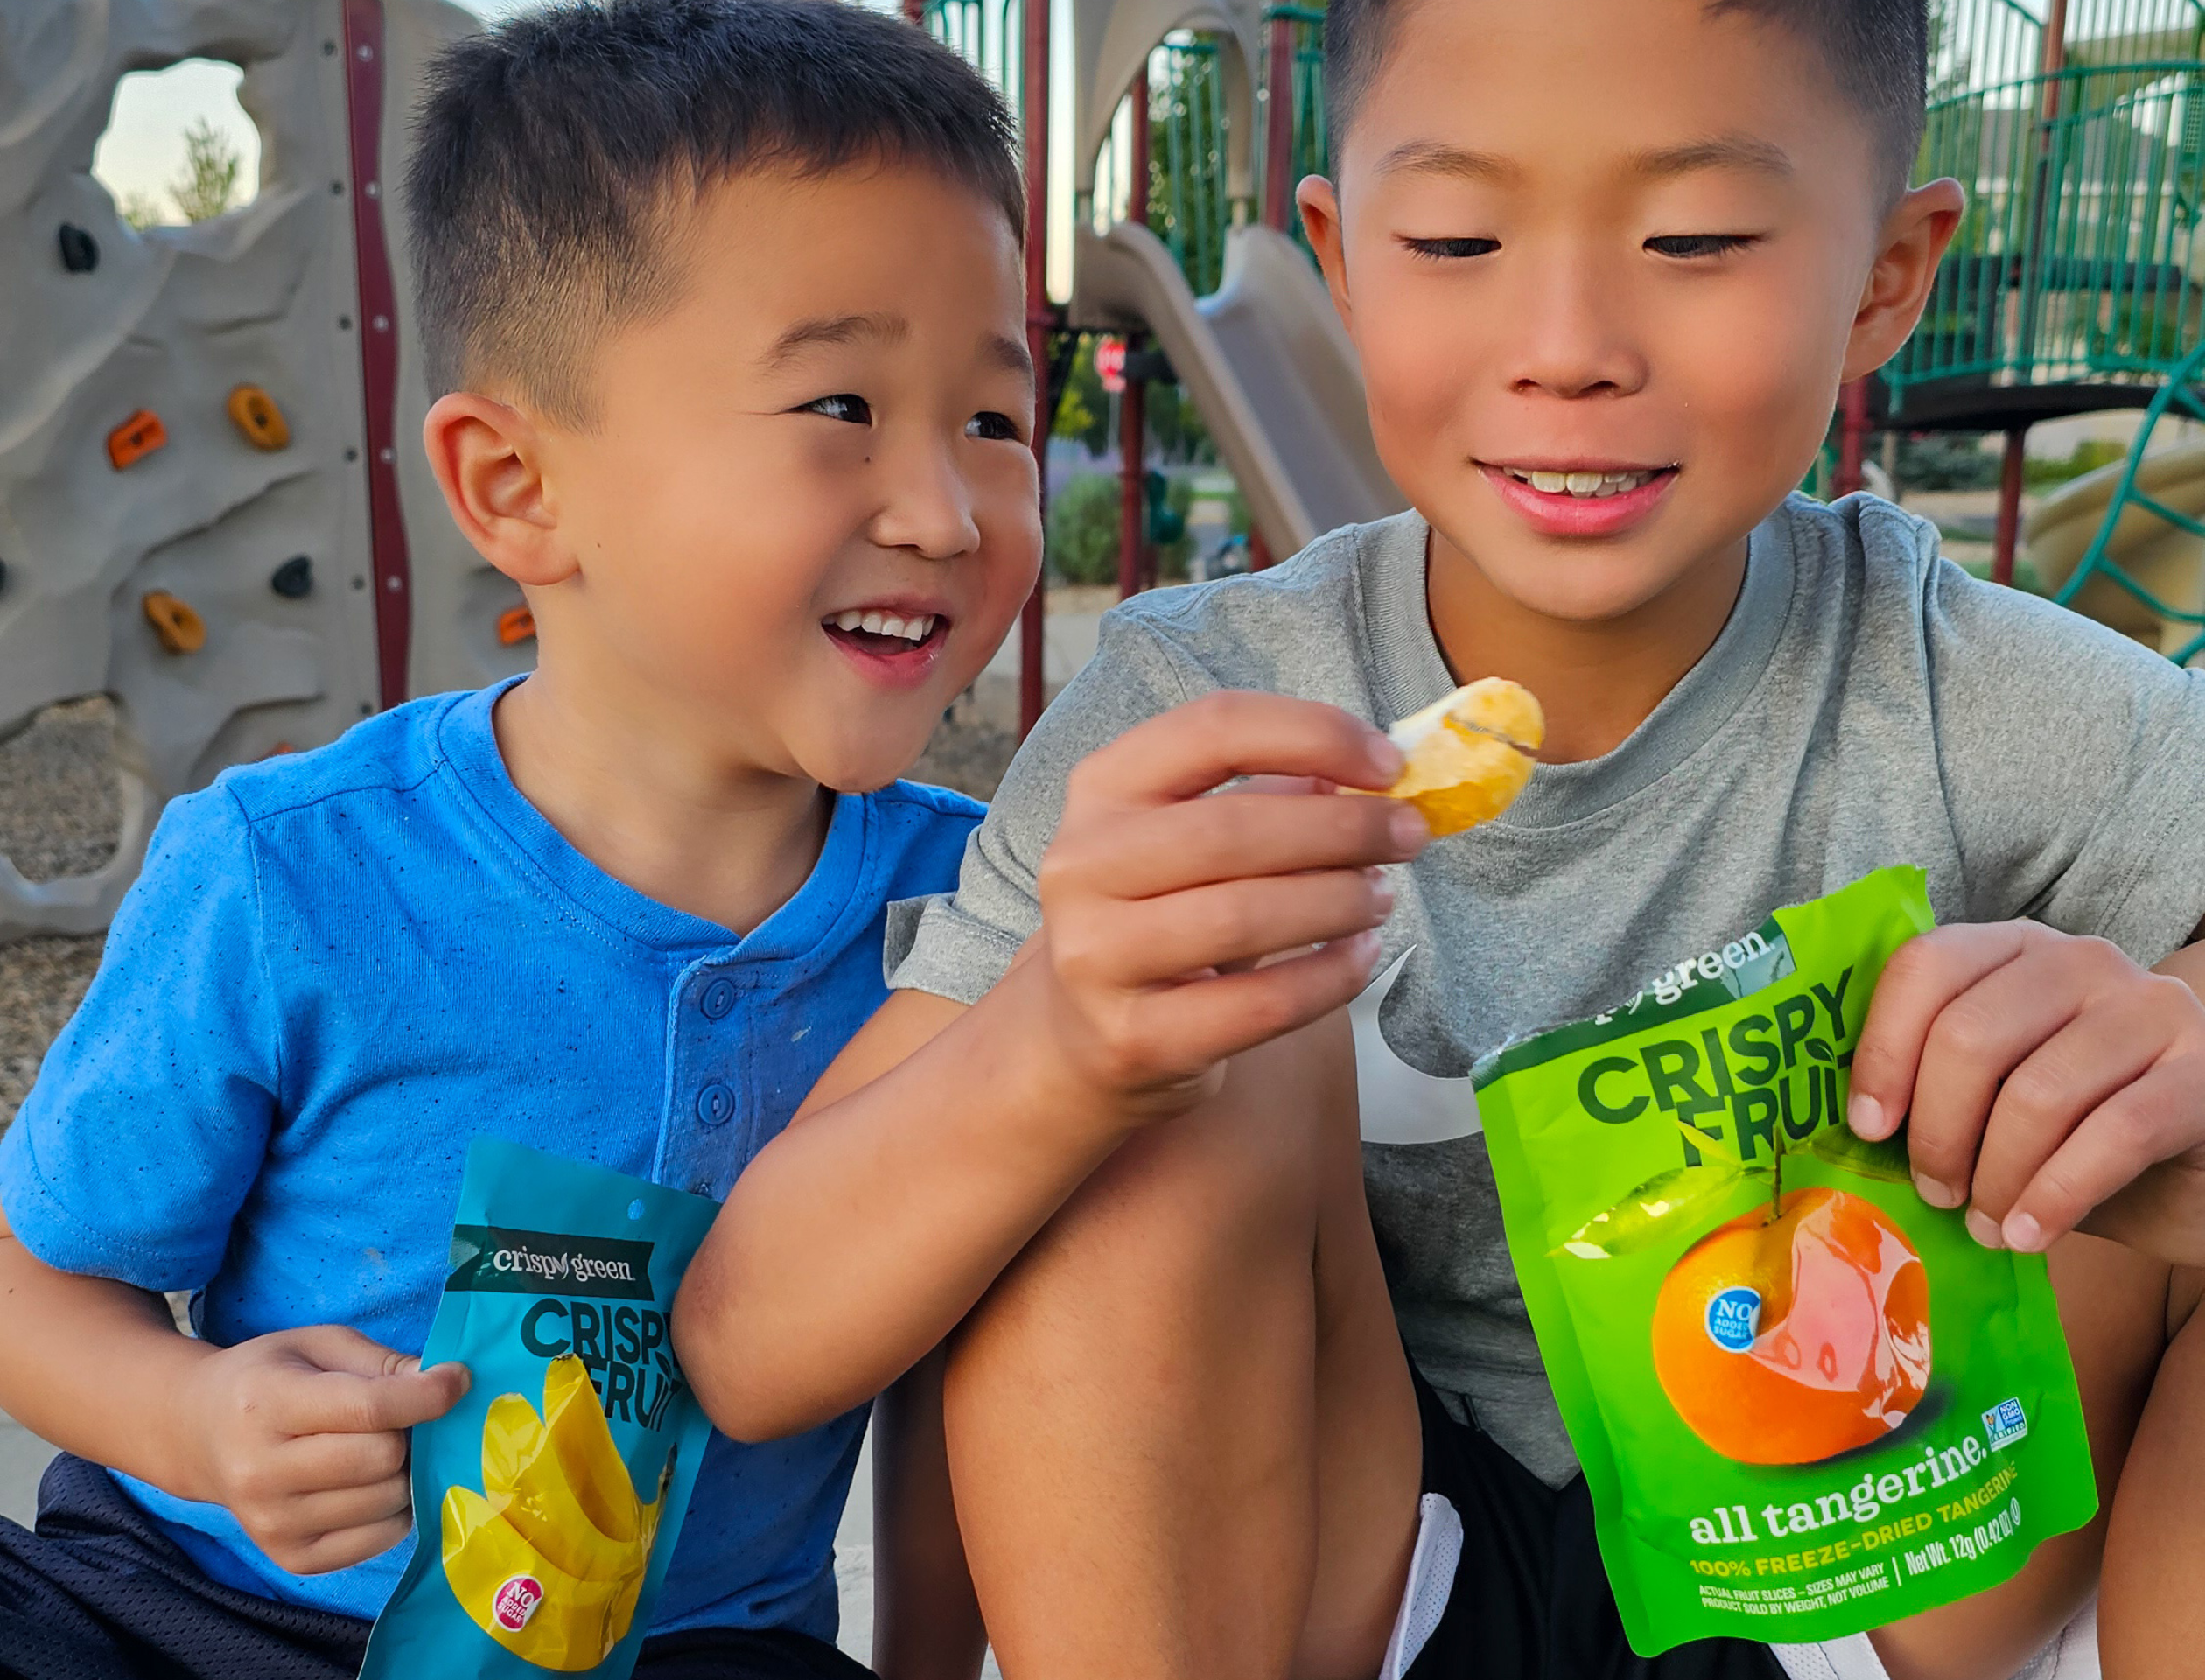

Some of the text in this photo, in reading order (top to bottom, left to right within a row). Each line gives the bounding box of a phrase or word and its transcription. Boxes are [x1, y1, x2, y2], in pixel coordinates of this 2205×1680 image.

[1577, 964, 1853, 1124] CRISPY
[494, 1246, 569, 1280] crispy
[1716, 1298, 1753, 1321] NO
[521, 1298, 680, 1368] CRISP
[1689, 1435, 1987, 1544] all tangerine.
[1690, 1460, 2017, 1576] 100% FREEZE-DRIED TANGERINE
[1949, 1533, 1977, 1560] 12g
[507, 1581, 535, 1607] NO
[1699, 1562, 1885, 1602] ACTUAL FRUIT SLICES SIZES MAY VARY
[1702, 1597, 1743, 1612] PRODUCT
[1744, 1602, 1769, 1615] SOLD
[1769, 1602, 1783, 1614] BY
[1826, 1588, 1850, 1606] NOT
[1849, 1576, 1890, 1599] VOLUME
